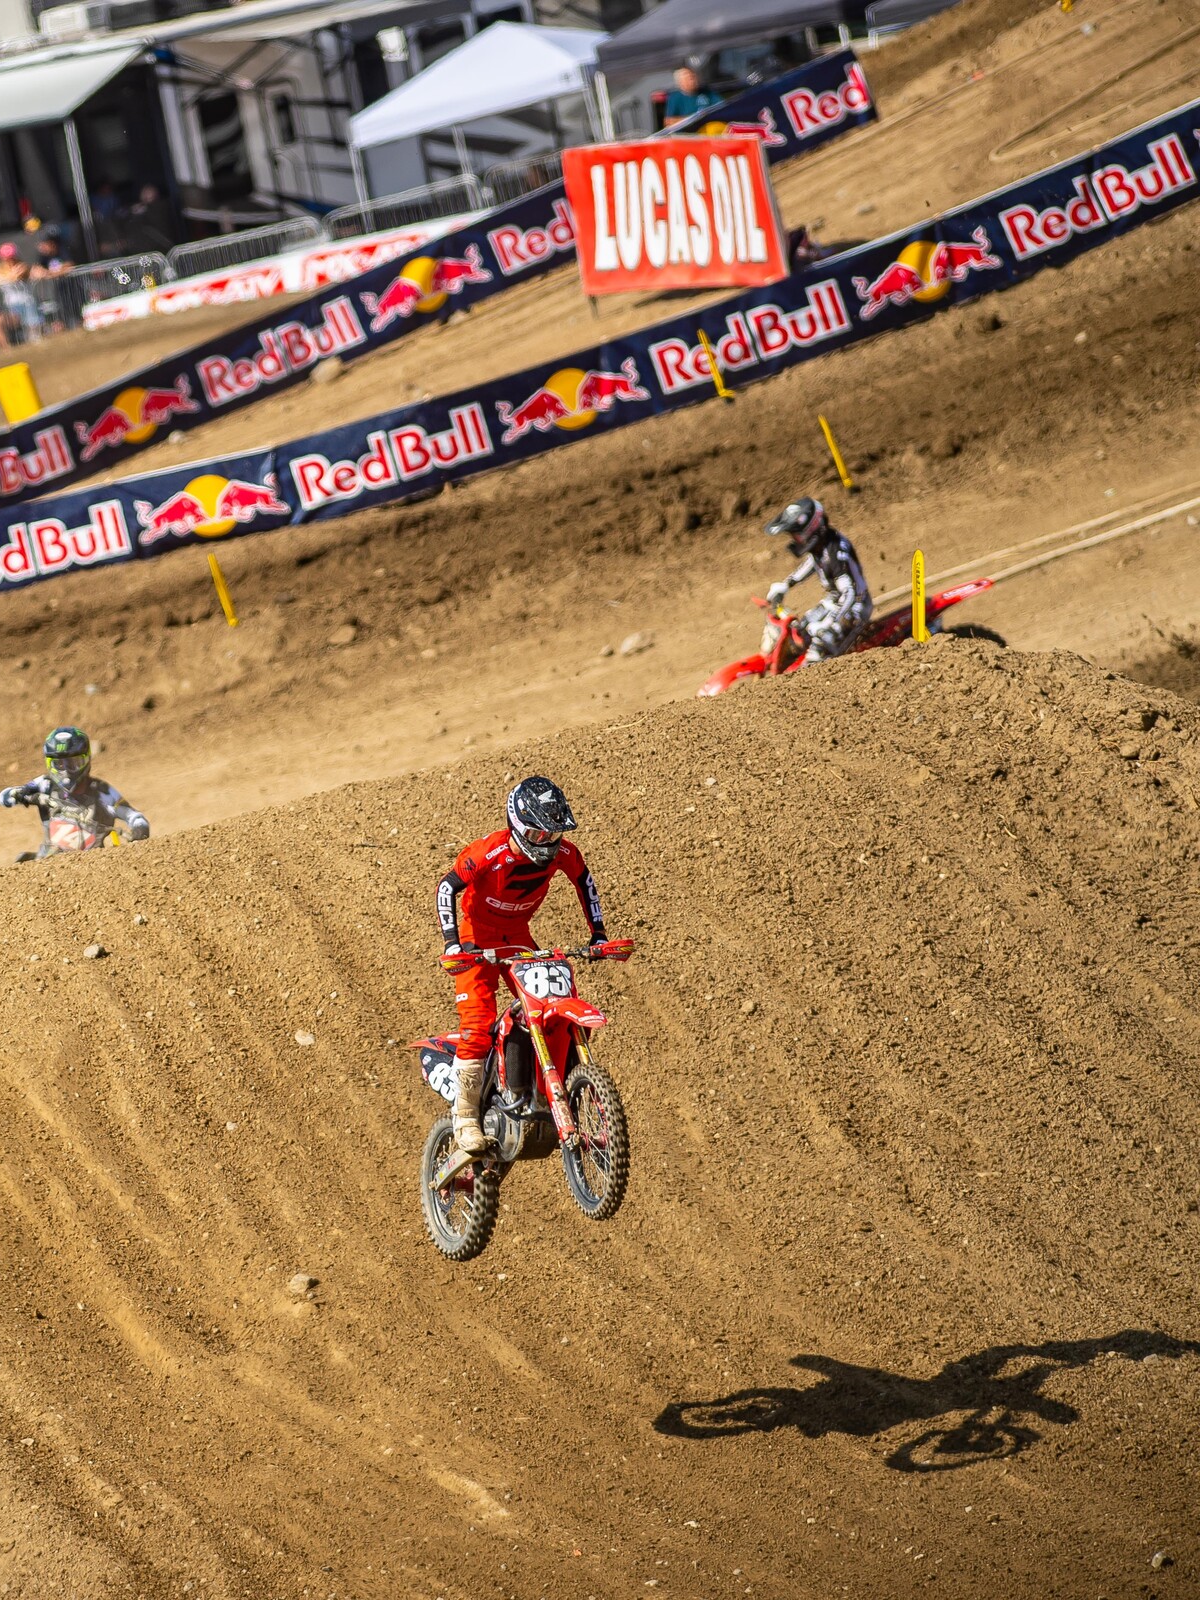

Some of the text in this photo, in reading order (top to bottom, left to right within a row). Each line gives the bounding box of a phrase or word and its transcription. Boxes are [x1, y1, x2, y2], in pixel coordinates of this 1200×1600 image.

[780, 61, 871, 139] Red
[487, 198, 576, 277] Red
[590, 153, 769, 271] LUCAS OIL
[998, 132, 1198, 261] Red Bull
[195, 329, 288, 408] Red
[275, 295, 367, 368] Bull
[647, 277, 853, 395] Red Bull
[289, 401, 494, 511] Red Bull
[27, 499, 132, 575] Bull
[523, 966, 572, 999] 83
[428, 1062, 457, 1101] 83
